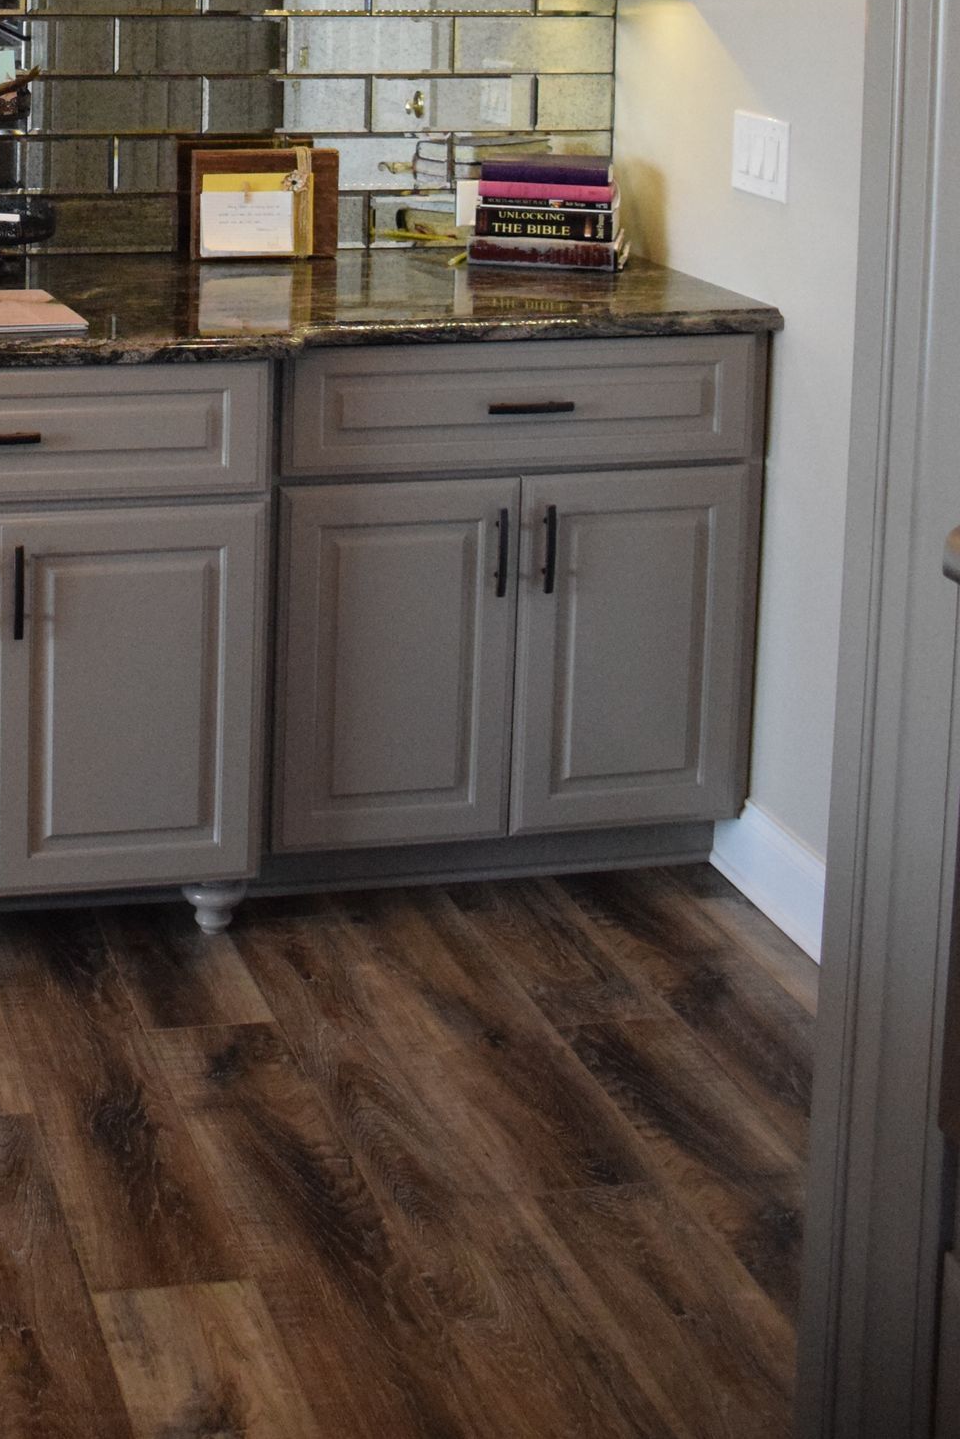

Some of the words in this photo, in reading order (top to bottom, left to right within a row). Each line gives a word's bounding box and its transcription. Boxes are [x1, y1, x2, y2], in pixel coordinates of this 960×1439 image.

[498, 210, 565, 222] UNLOCKING
[492, 222, 522, 234] THE
[527, 223, 571, 236] BIBLE
